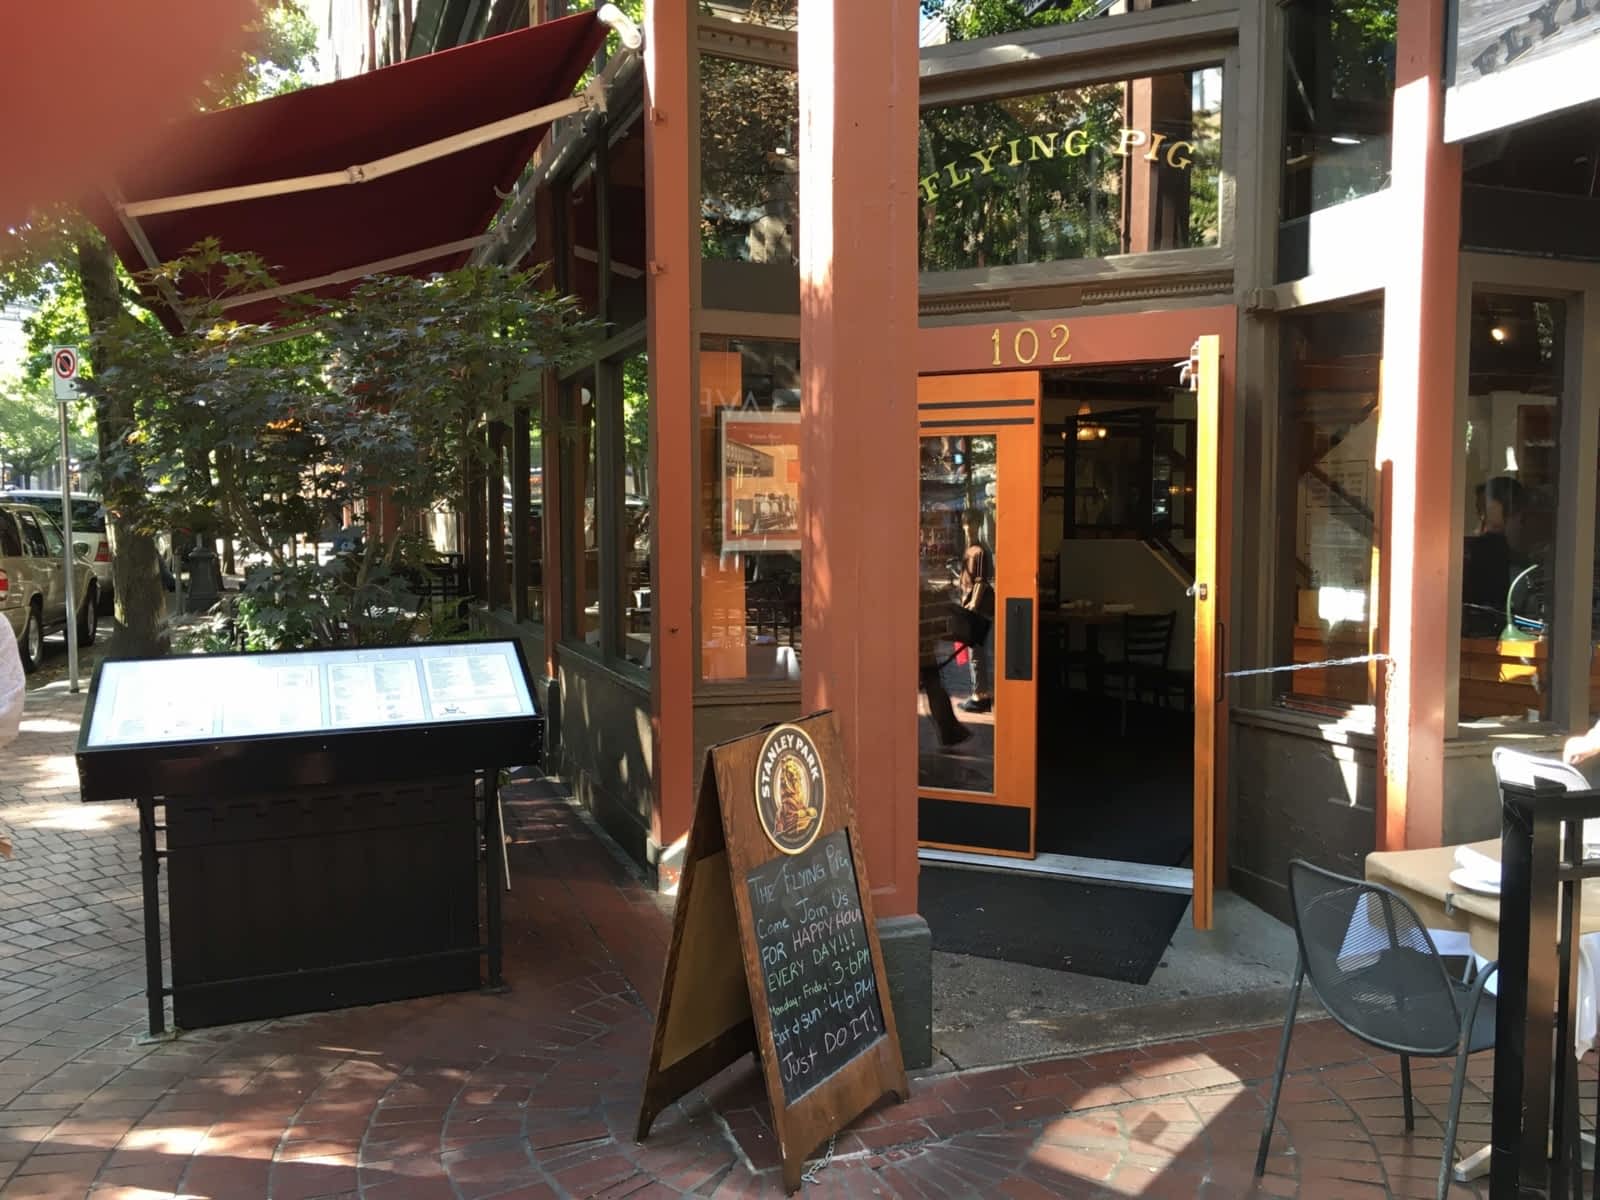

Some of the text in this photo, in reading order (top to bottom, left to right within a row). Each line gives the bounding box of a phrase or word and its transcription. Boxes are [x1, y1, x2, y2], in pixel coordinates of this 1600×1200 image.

[919, 129, 1196, 204] FLYING PIG
[991, 323, 1072, 366] 102
[761, 734, 819, 798] STANLEY PARK
[761, 942, 788, 969] FOR
[791, 918, 833, 952] HAPPY
[768, 960, 805, 992] EVERY
